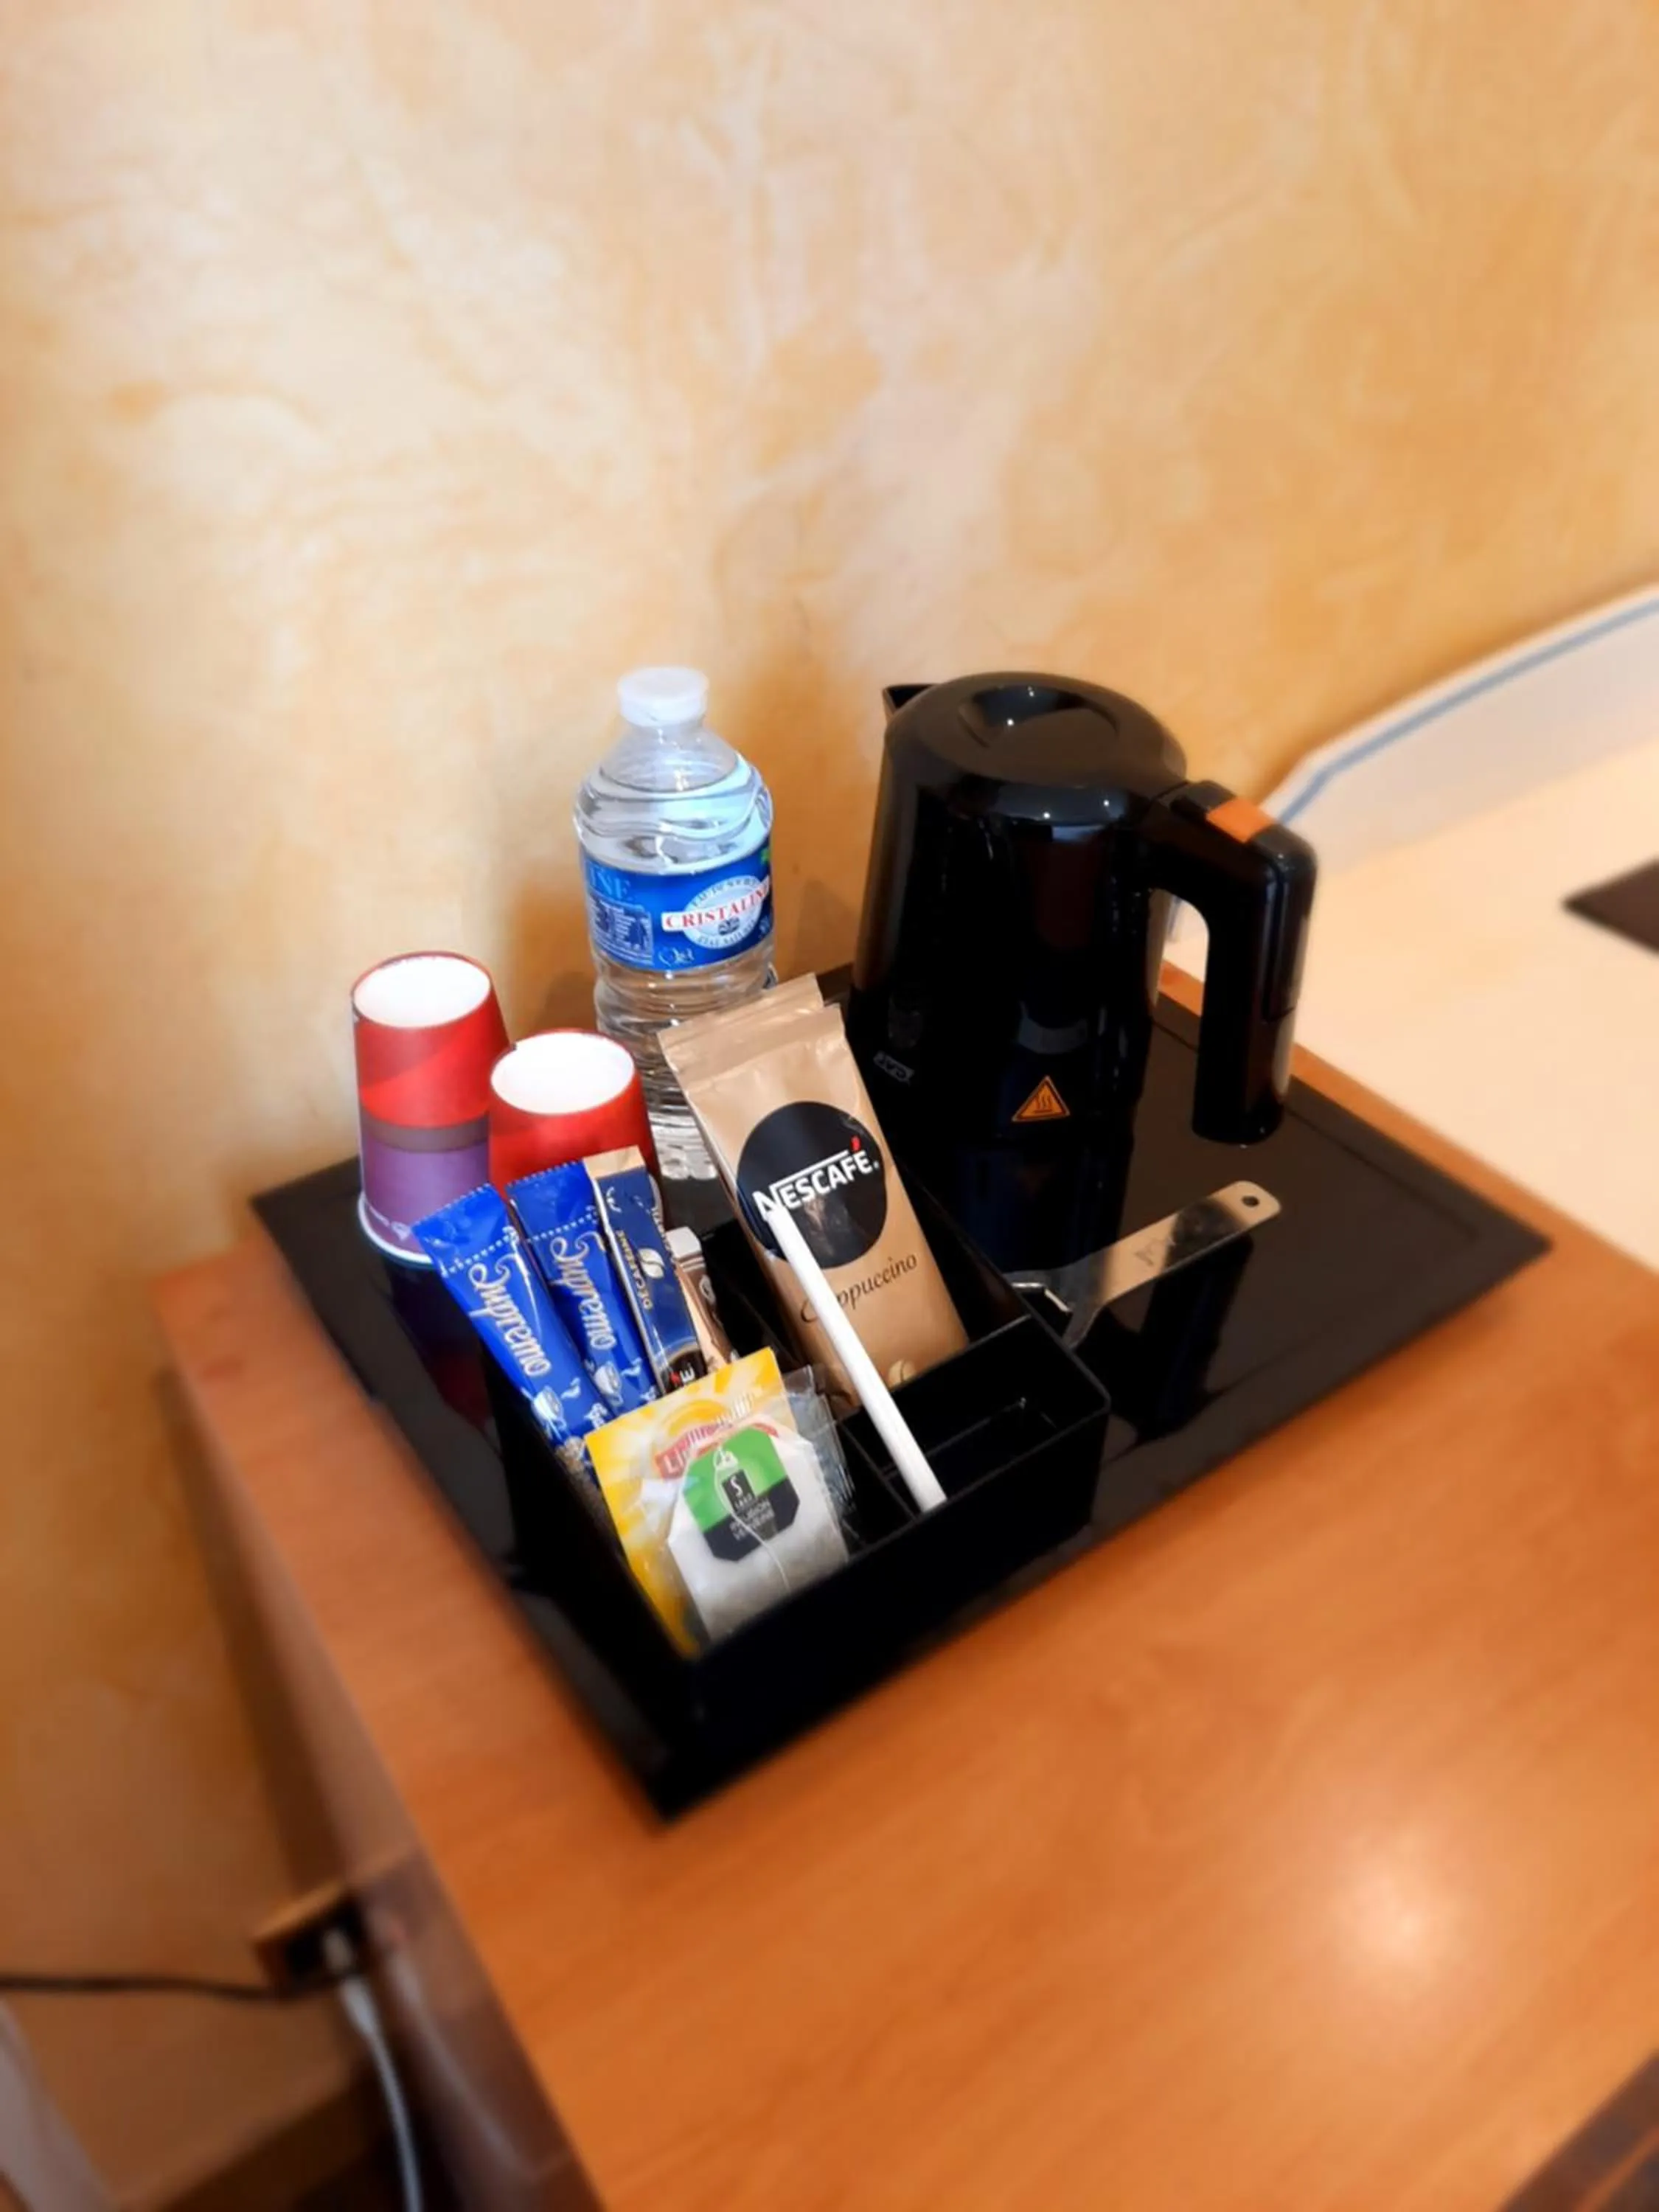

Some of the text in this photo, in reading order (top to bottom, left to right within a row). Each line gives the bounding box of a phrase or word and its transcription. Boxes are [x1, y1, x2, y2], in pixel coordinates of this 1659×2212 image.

[468, 1253, 552, 1378] Supremo
[549, 1231, 616, 1351] Supremo
[800, 1253, 918, 1324] Cppuccino
